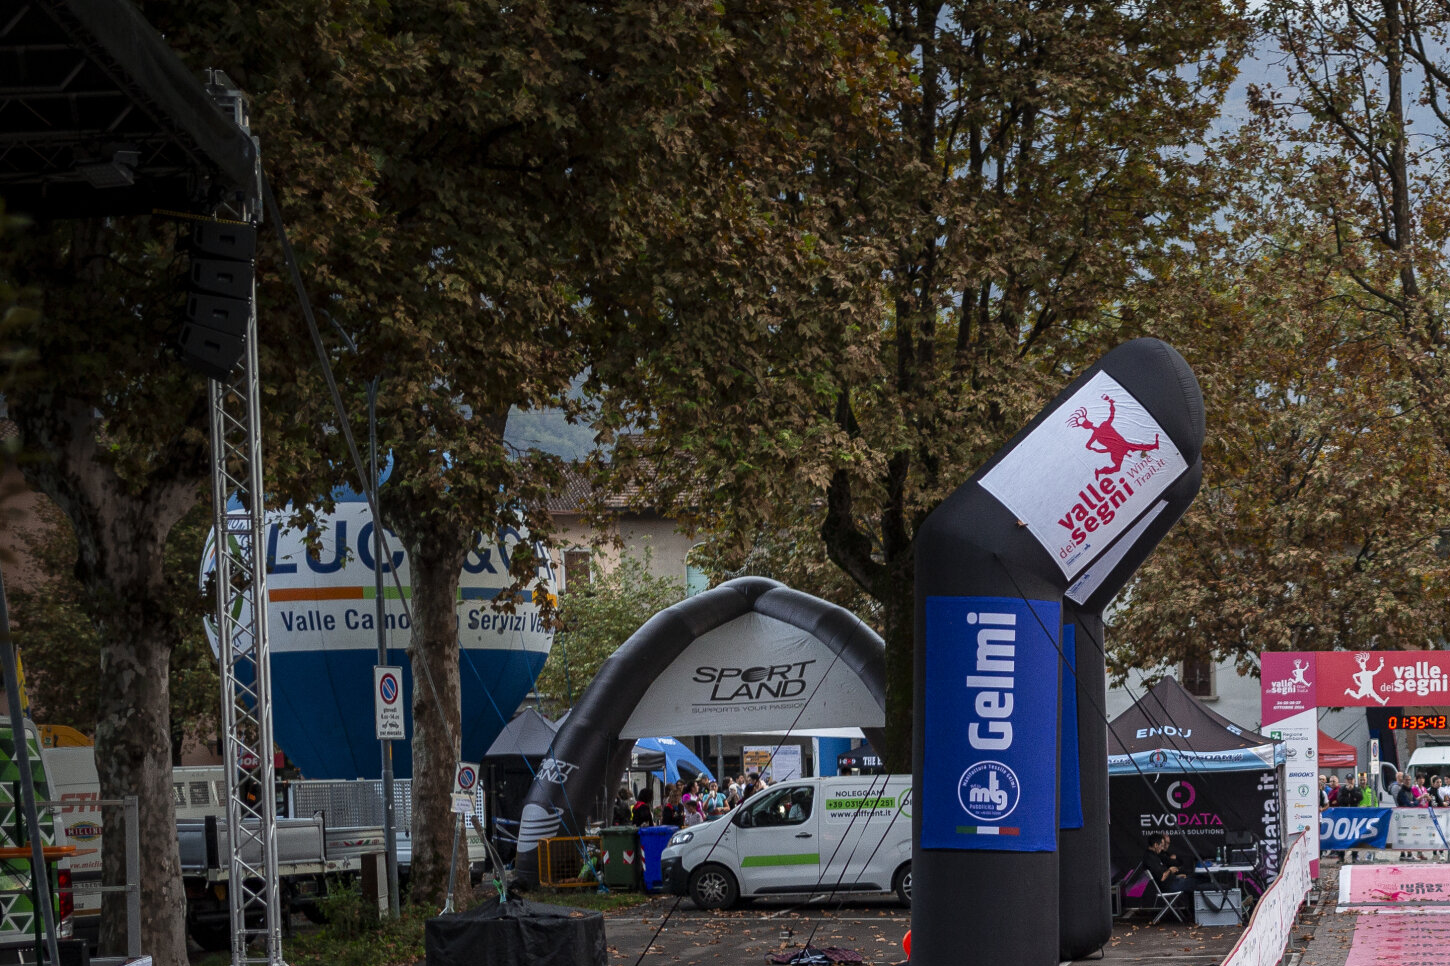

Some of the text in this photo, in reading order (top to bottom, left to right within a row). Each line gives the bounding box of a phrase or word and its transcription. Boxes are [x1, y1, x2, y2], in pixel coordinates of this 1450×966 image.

[1126, 455, 1153, 479] Wine
[1134, 458, 1166, 487] Trail.it
[1058, 477, 1116, 531] valle
[1059, 540, 1077, 559] dei
[1072, 478, 1134, 545] segni
[281, 608, 336, 632] Valle
[468, 609, 527, 633] Servizi
[692, 660, 816, 683] SPORT
[966, 612, 1016, 750] Gelmi
[1393, 661, 1441, 679] valle
[710, 679, 807, 701] LAND
[1272, 684, 1296, 695] segni
[1380, 674, 1448, 696] dei segni
[691, 706, 740, 714] SUPPORTS
[1136, 725, 1192, 739] ENDU
[1140, 813, 1223, 827] EVODATA
[1187, 828, 1224, 836] SOLUTIONS
